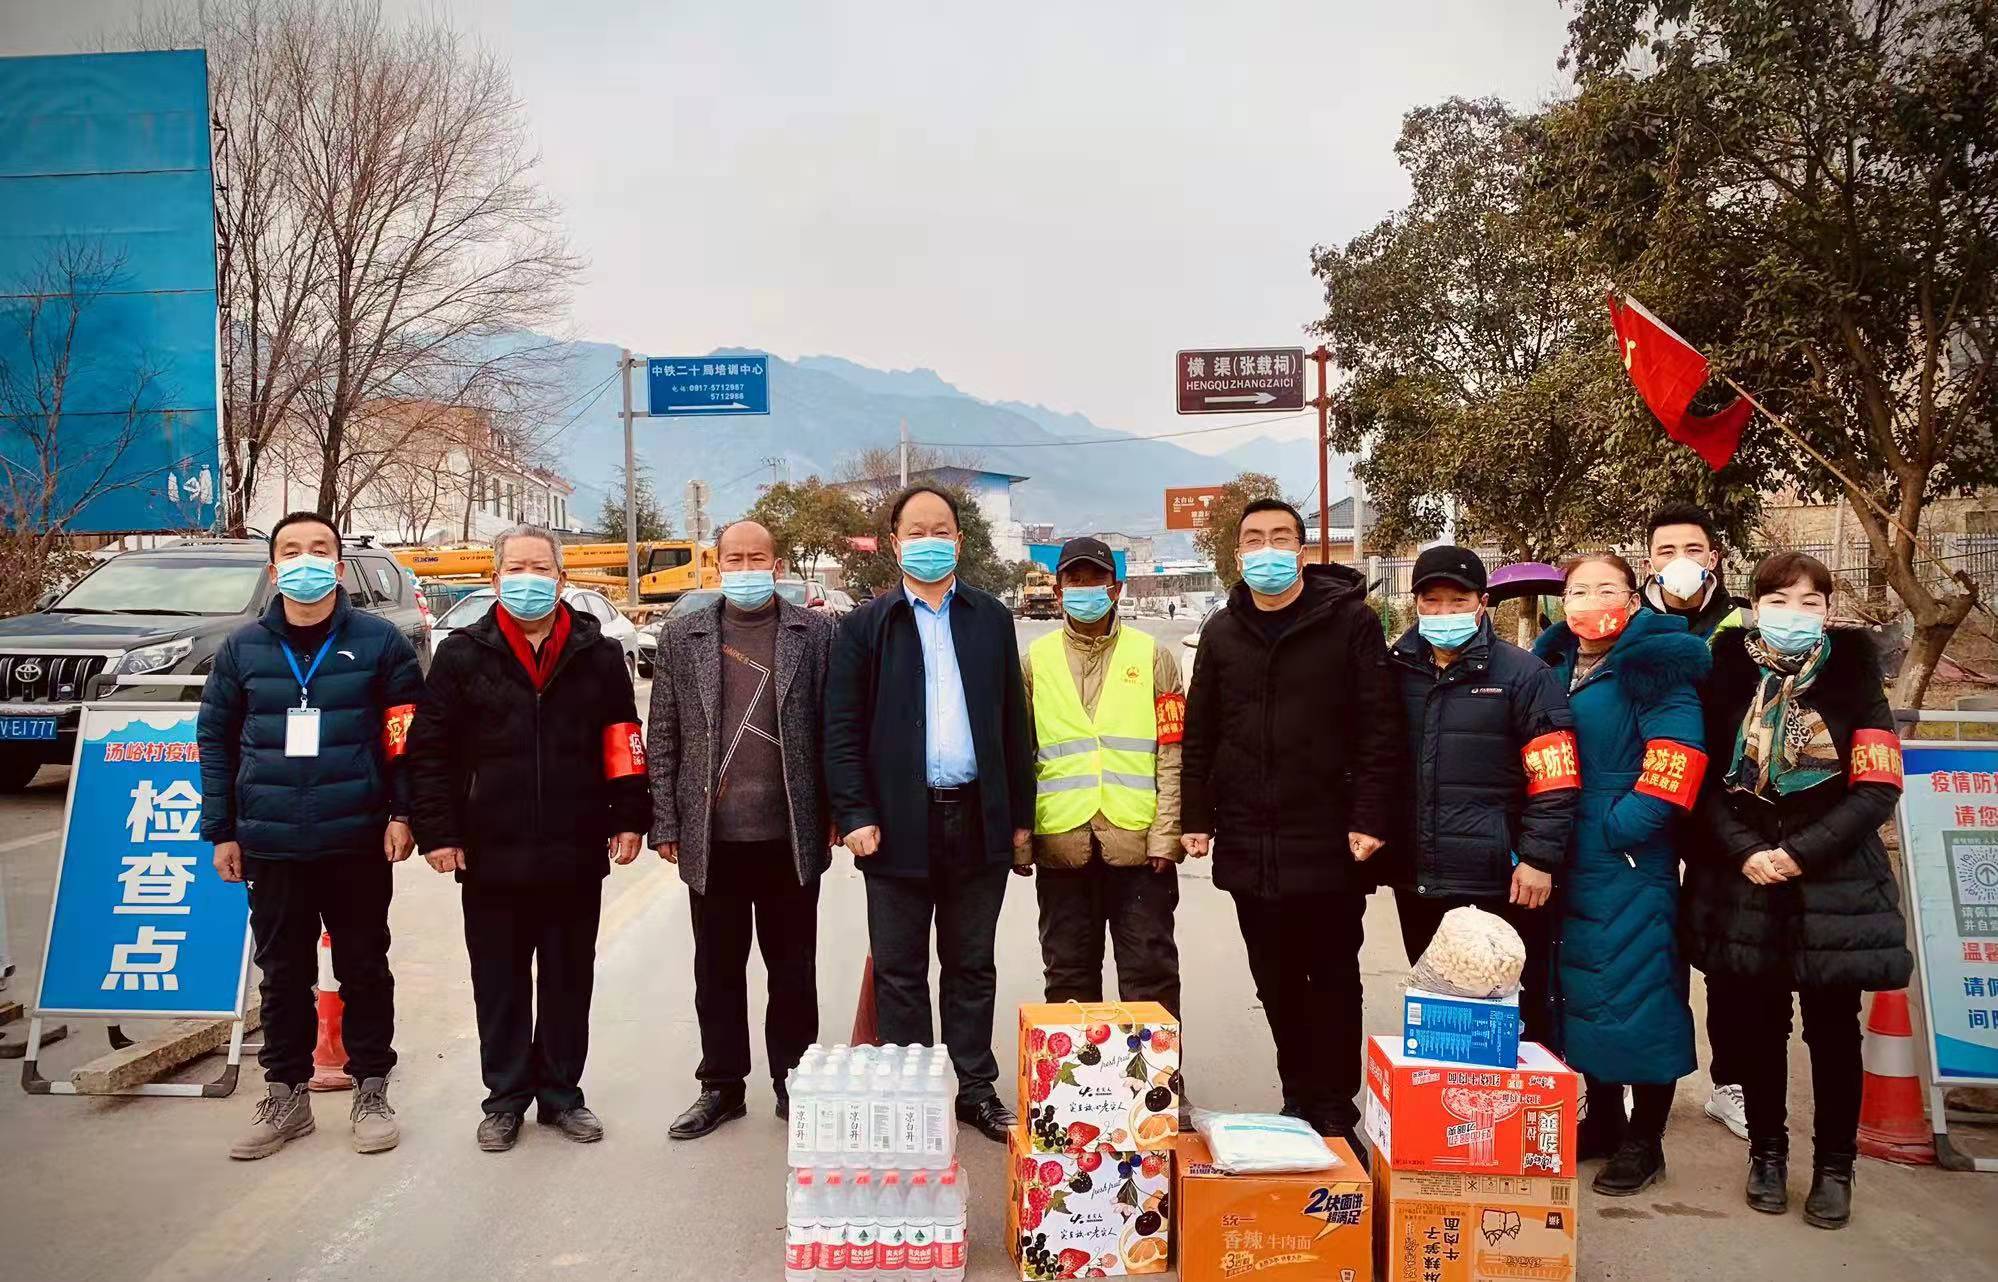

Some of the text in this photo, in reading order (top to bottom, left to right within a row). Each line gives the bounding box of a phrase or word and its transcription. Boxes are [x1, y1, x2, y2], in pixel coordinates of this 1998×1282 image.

[651, 364, 764, 377] 中铁二十局培训中心
[1930, 770, 1998, 793] 疫情防
[100, 780, 202, 991] 检查点
[850, 1111, 859, 1141] 凉白开
[905, 1112, 915, 1142] 凉白开
[1304, 1188, 1363, 1214] 2块面饼
[1222, 1215, 1256, 1227] 统一
[1327, 1210, 1362, 1225] 超满足
[1443, 1218, 1460, 1260] 牛肉面
